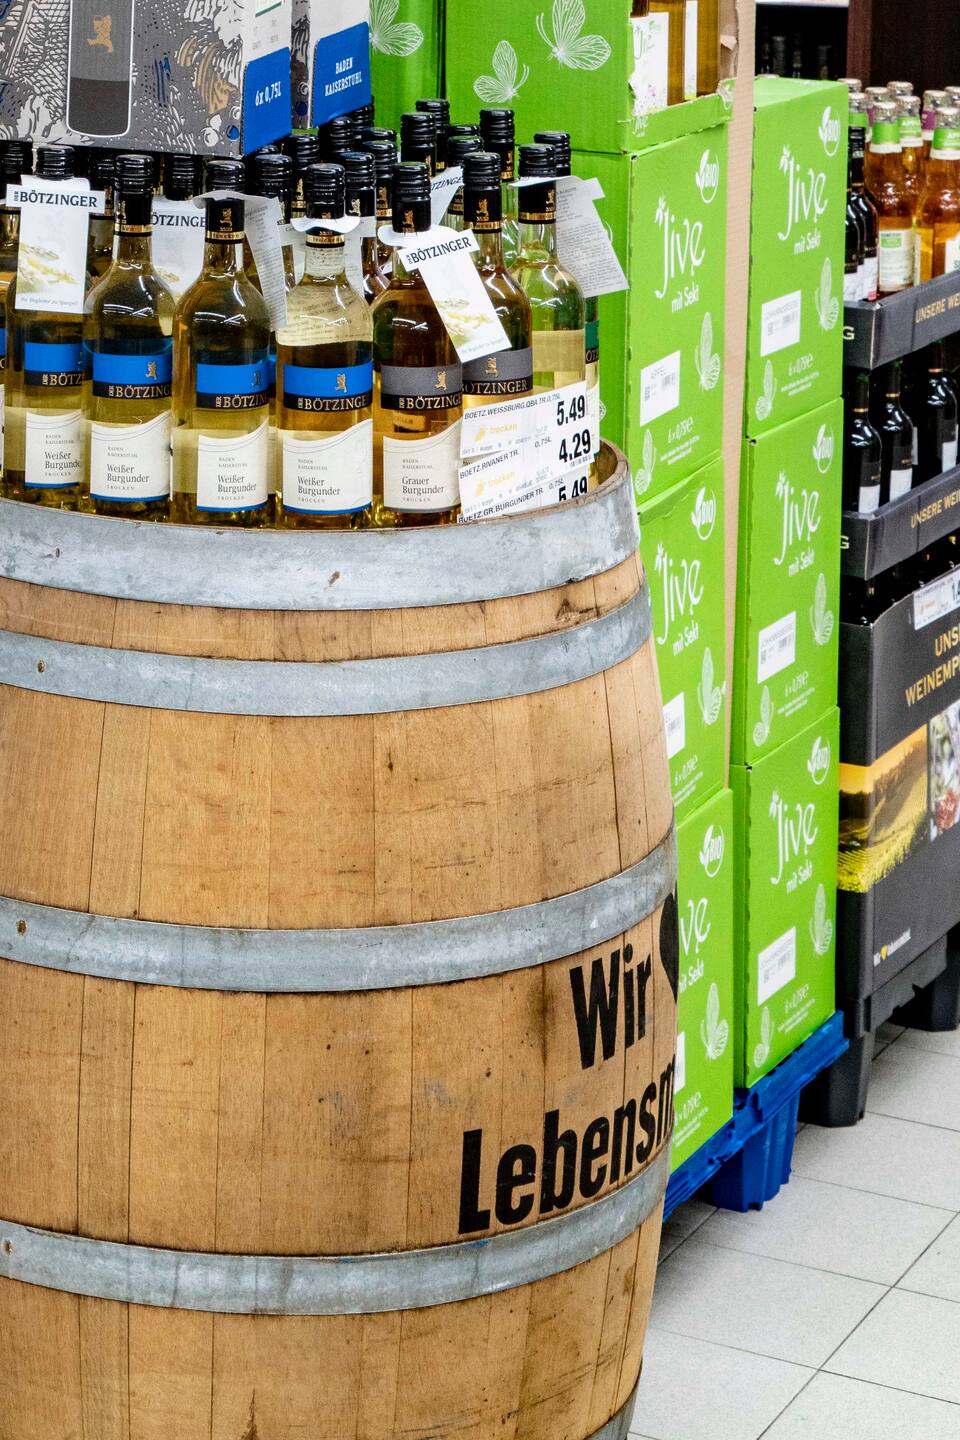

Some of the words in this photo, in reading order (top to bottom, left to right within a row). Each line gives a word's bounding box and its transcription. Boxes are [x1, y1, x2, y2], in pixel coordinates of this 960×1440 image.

[335, 56, 354, 75] BADEN
[324, 71, 363, 97] KAISERSTUHL
[20, 189, 97, 208] BÖTZINGER
[777, 155, 829, 241] Jive
[410, 236, 472, 264] BÖTZINGER
[654, 208, 706, 300] Jive
[794, 237, 806, 255] mit
[806, 228, 822, 252] Sekt
[671, 290, 683, 313] mit
[684, 281, 700, 307] Sekt
[915, 294, 946, 324] UNSERE
[304, 395, 367, 411] BÖTZINGE
[406, 394, 463, 410] BÖTZINGE
[556, 394, 586, 427] 5.49
[44, 450, 72, 461] Weißer
[558, 428, 591, 463] 4.29
[44, 459, 81, 471] Burgunde
[106, 463, 135, 474] Weißer
[106, 472, 150, 484] Burgunder
[459, 452, 509, 480] BOETZ.RIVANER
[217, 474, 245, 484] Weißer
[217, 482, 257, 494] Burgunder
[297, 475, 325, 486] Weißer
[297, 486, 341, 497] Burgunder
[401, 475, 430, 487] Grauer
[402, 485, 445, 497] Burgunder
[701, 502, 713, 525] BIO
[773, 480, 822, 566] Jive
[910, 497, 942, 529] UNSERE
[788, 560, 800, 577] mit
[800, 547, 815, 571] Sekt
[656, 552, 704, 646] Jive
[672, 637, 684, 656] mit
[684, 622, 699, 648] Sekt
[816, 750, 829, 769] BIO
[709, 839, 723, 861] BIO
[770, 799, 818, 886] Jive
[786, 876, 798, 894] mit
[798, 862, 813, 885] Sekt
[680, 897, 711, 955] ve
[688, 957, 705, 987] Sekt
[569, 943, 652, 1070] Wir
[458, 1054, 676, 1235] Lebensm
